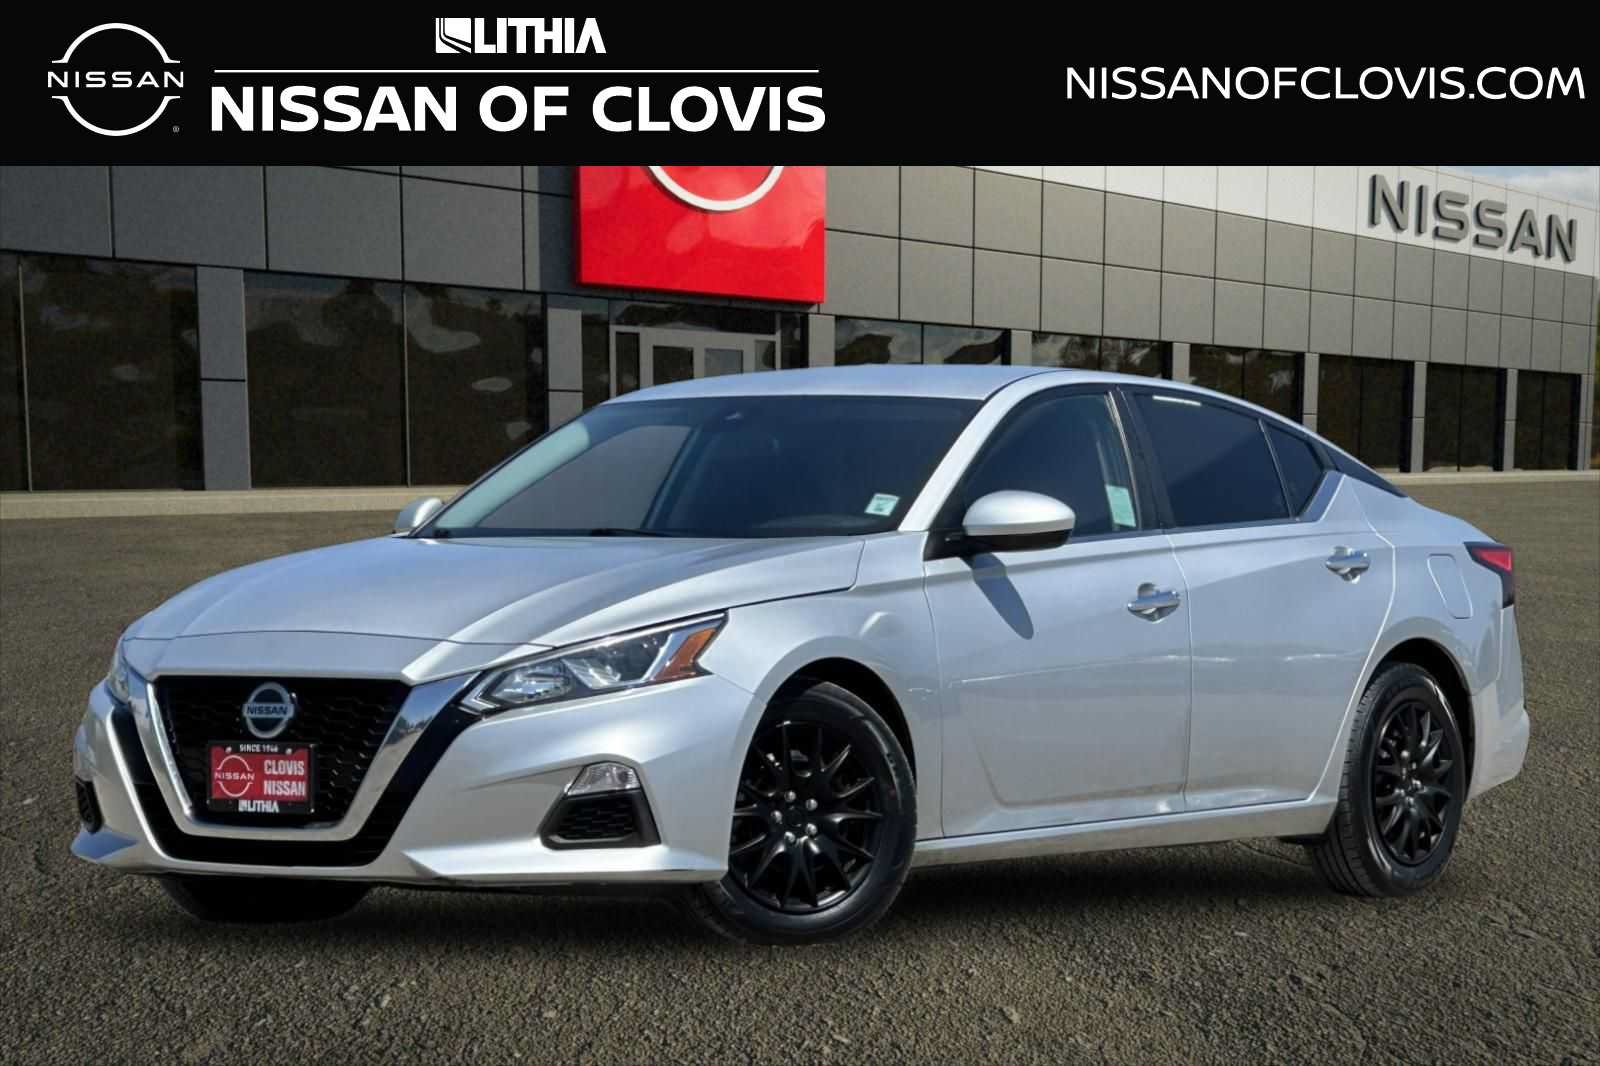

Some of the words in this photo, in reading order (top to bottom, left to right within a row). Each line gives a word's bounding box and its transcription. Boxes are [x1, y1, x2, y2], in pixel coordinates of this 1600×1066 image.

[1368, 173, 1578, 263] NISSAN
[246, 705, 289, 716] NISSAN
[239, 744, 261, 752] SINCE
[263, 760, 305, 775] CLOVIS
[214, 772, 255, 780] NISSAN
[263, 780, 306, 796] NISSAN
[247, 800, 280, 813] LITHIA
